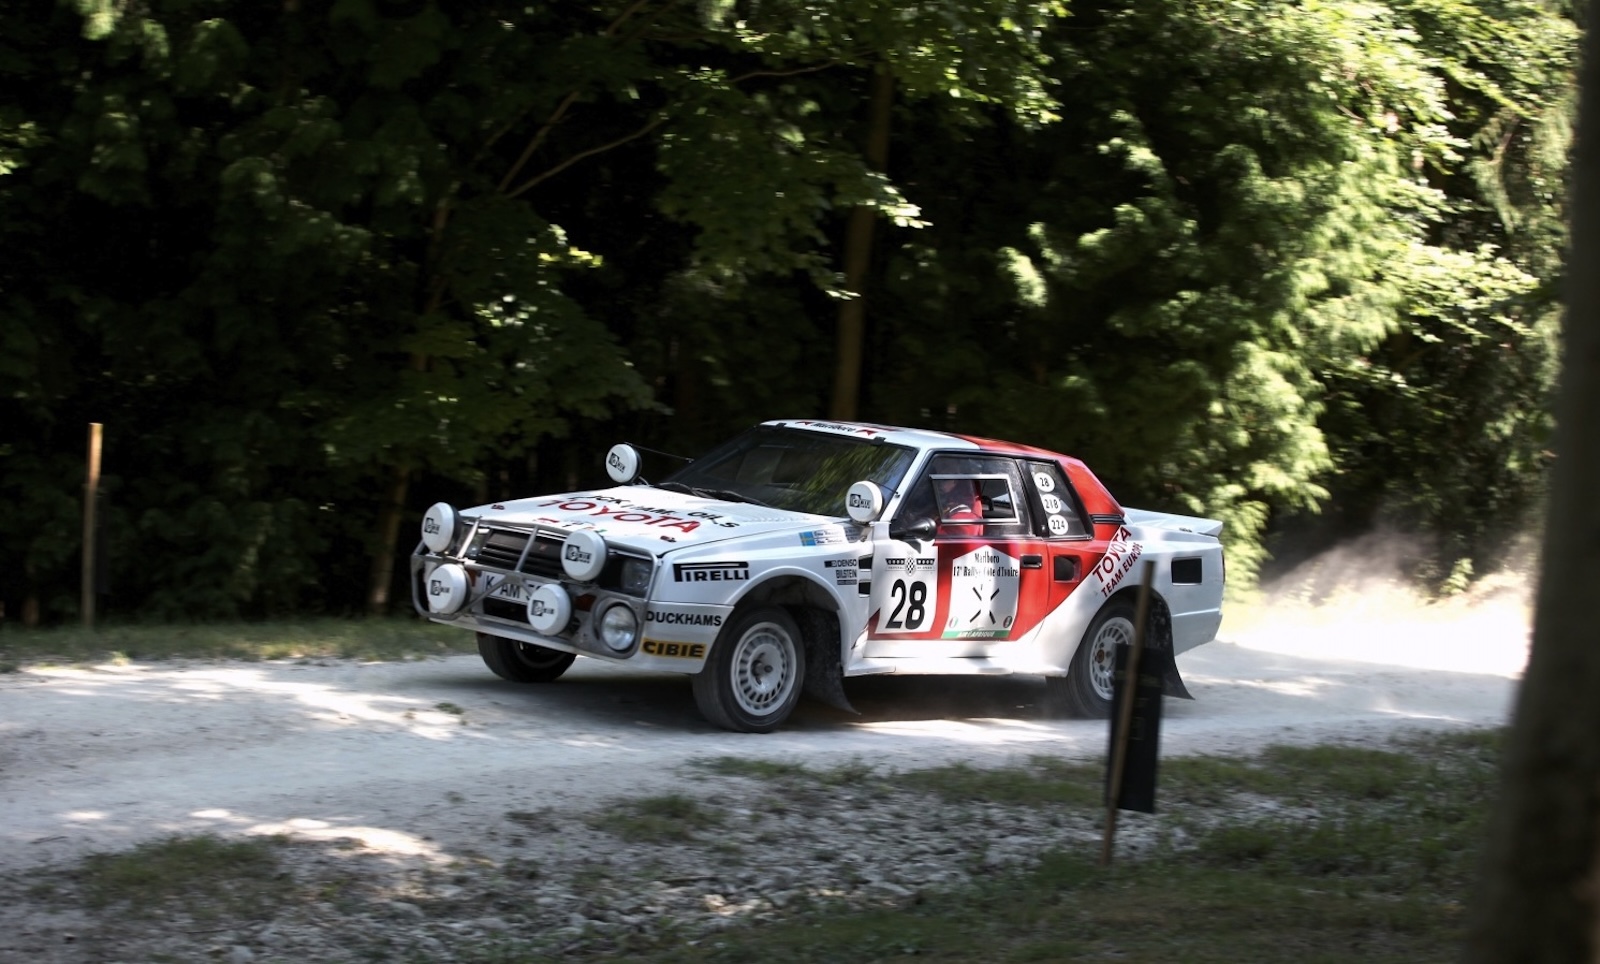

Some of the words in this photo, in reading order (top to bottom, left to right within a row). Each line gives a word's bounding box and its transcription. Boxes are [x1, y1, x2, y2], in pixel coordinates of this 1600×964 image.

[1040, 477, 1050, 487] 28
[1045, 499, 1058, 509] 218
[536, 498, 701, 533] TOYOTA
[1052, 519, 1065, 530] 224
[975, 551, 999, 563] Marlboro
[1092, 526, 1132, 583] TOYOTA
[673, 561, 749, 582] PIRELLI
[1101, 568, 1124, 597] TEAM
[885, 579, 927, 630] 28
[646, 611, 722, 626] DUCKHAMS
